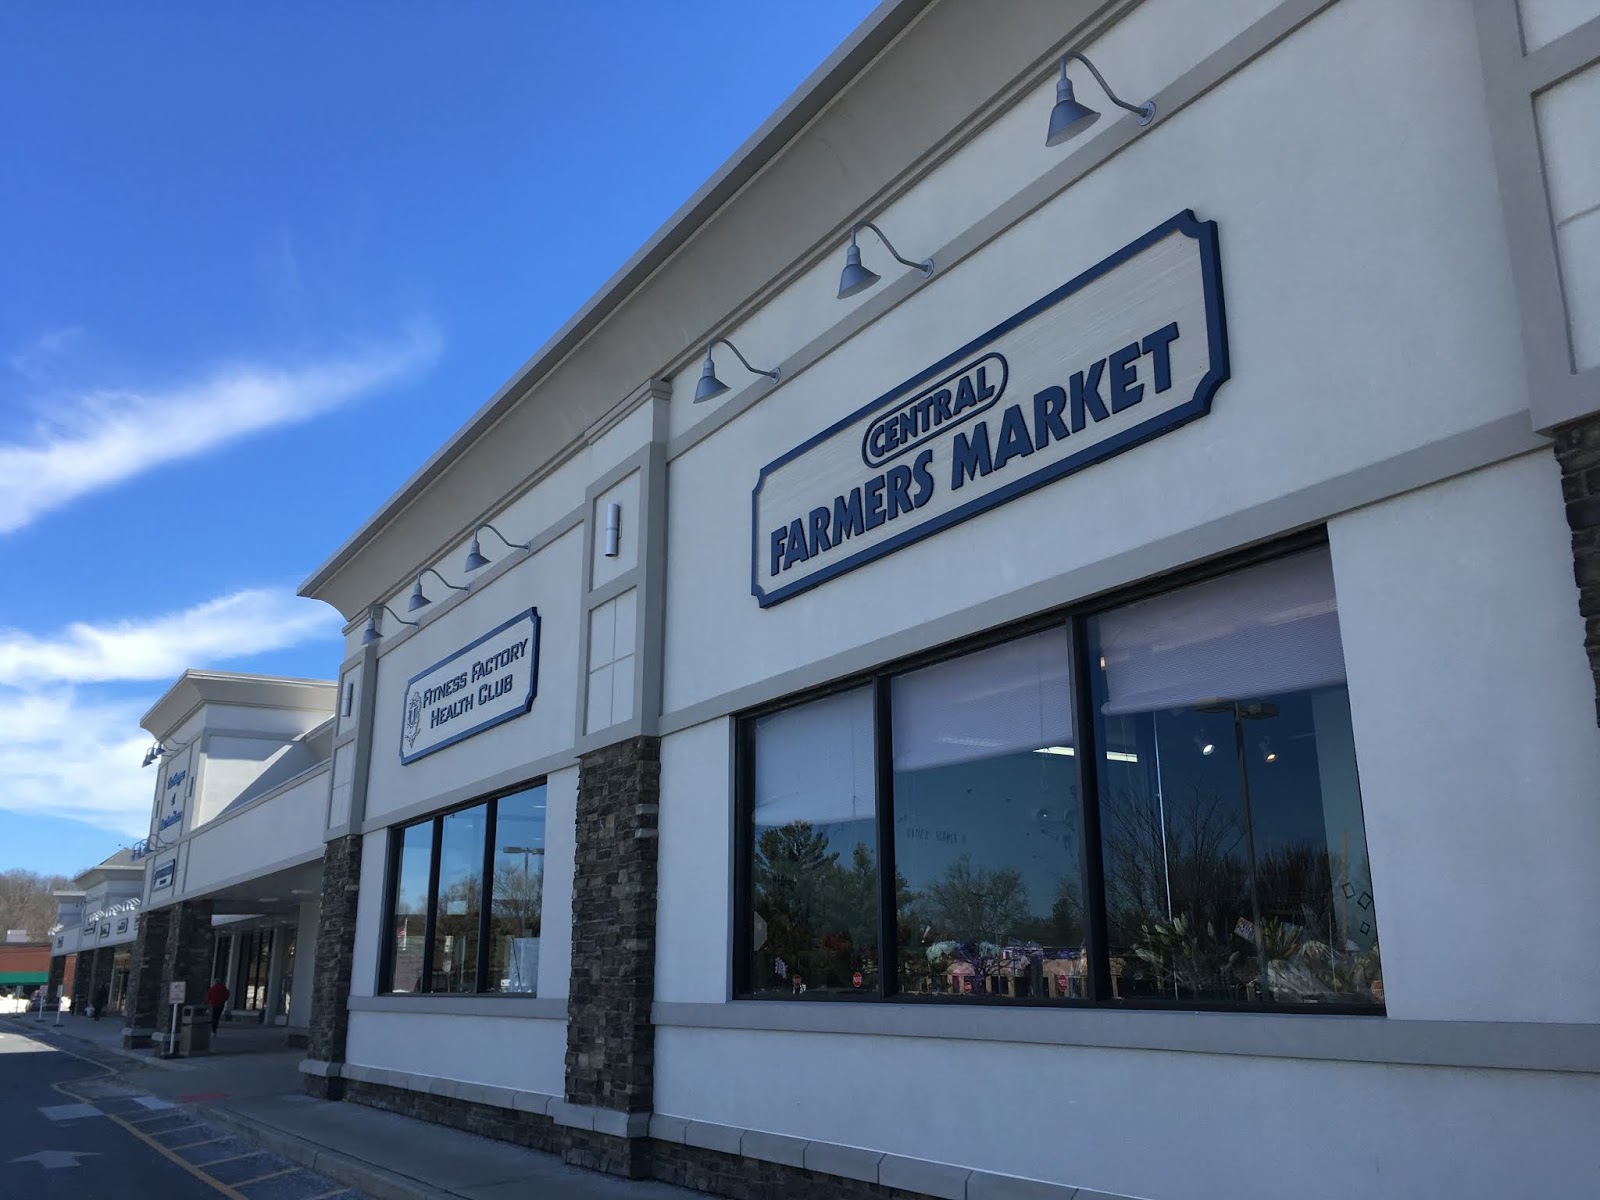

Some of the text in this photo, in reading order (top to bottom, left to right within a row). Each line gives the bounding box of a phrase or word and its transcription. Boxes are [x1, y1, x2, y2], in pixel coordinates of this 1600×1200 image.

[770, 321, 1180, 577] FARMERS MARKET
[869, 366, 995, 459] CENTRAL
[422, 638, 529, 709] FITNESS FACTORY
[430, 673, 513, 729] HEALTH CLUB
